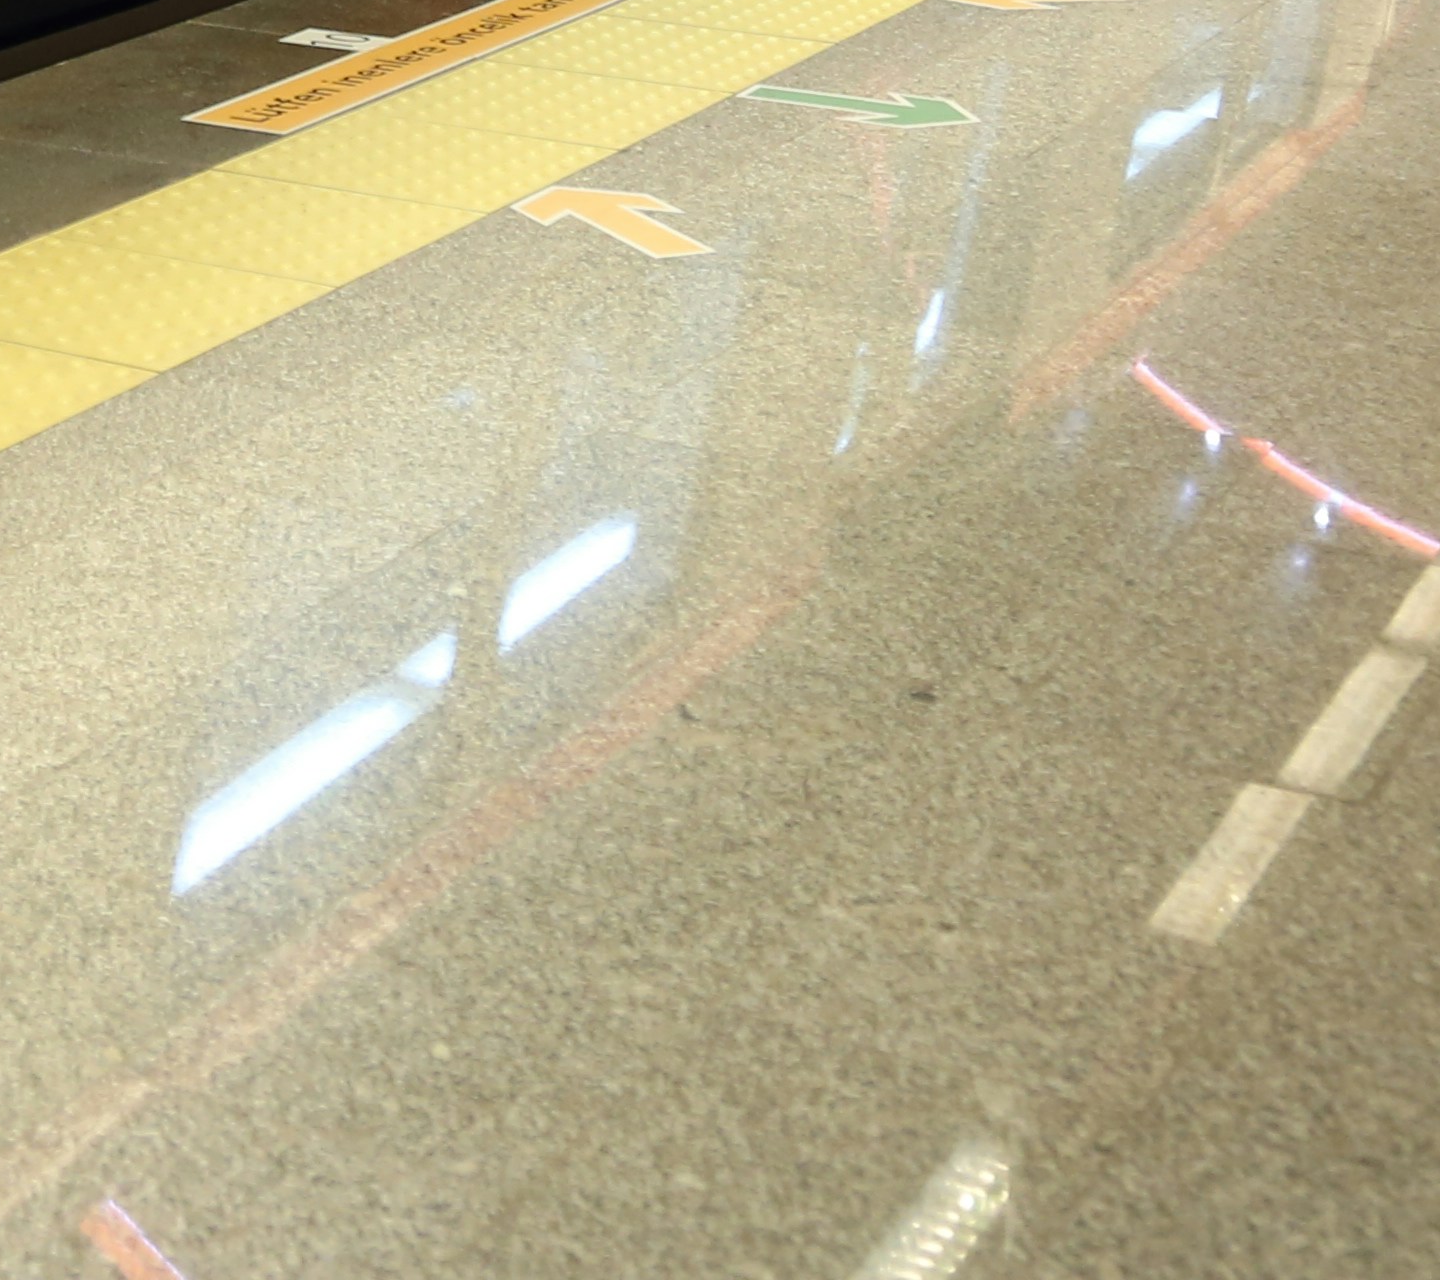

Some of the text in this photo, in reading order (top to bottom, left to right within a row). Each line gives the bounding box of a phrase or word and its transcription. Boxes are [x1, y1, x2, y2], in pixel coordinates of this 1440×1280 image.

[230, 87, 341, 124] Lütfen
[323, 45, 447, 88] inenlere
[431, 13, 534, 46] öncelik
